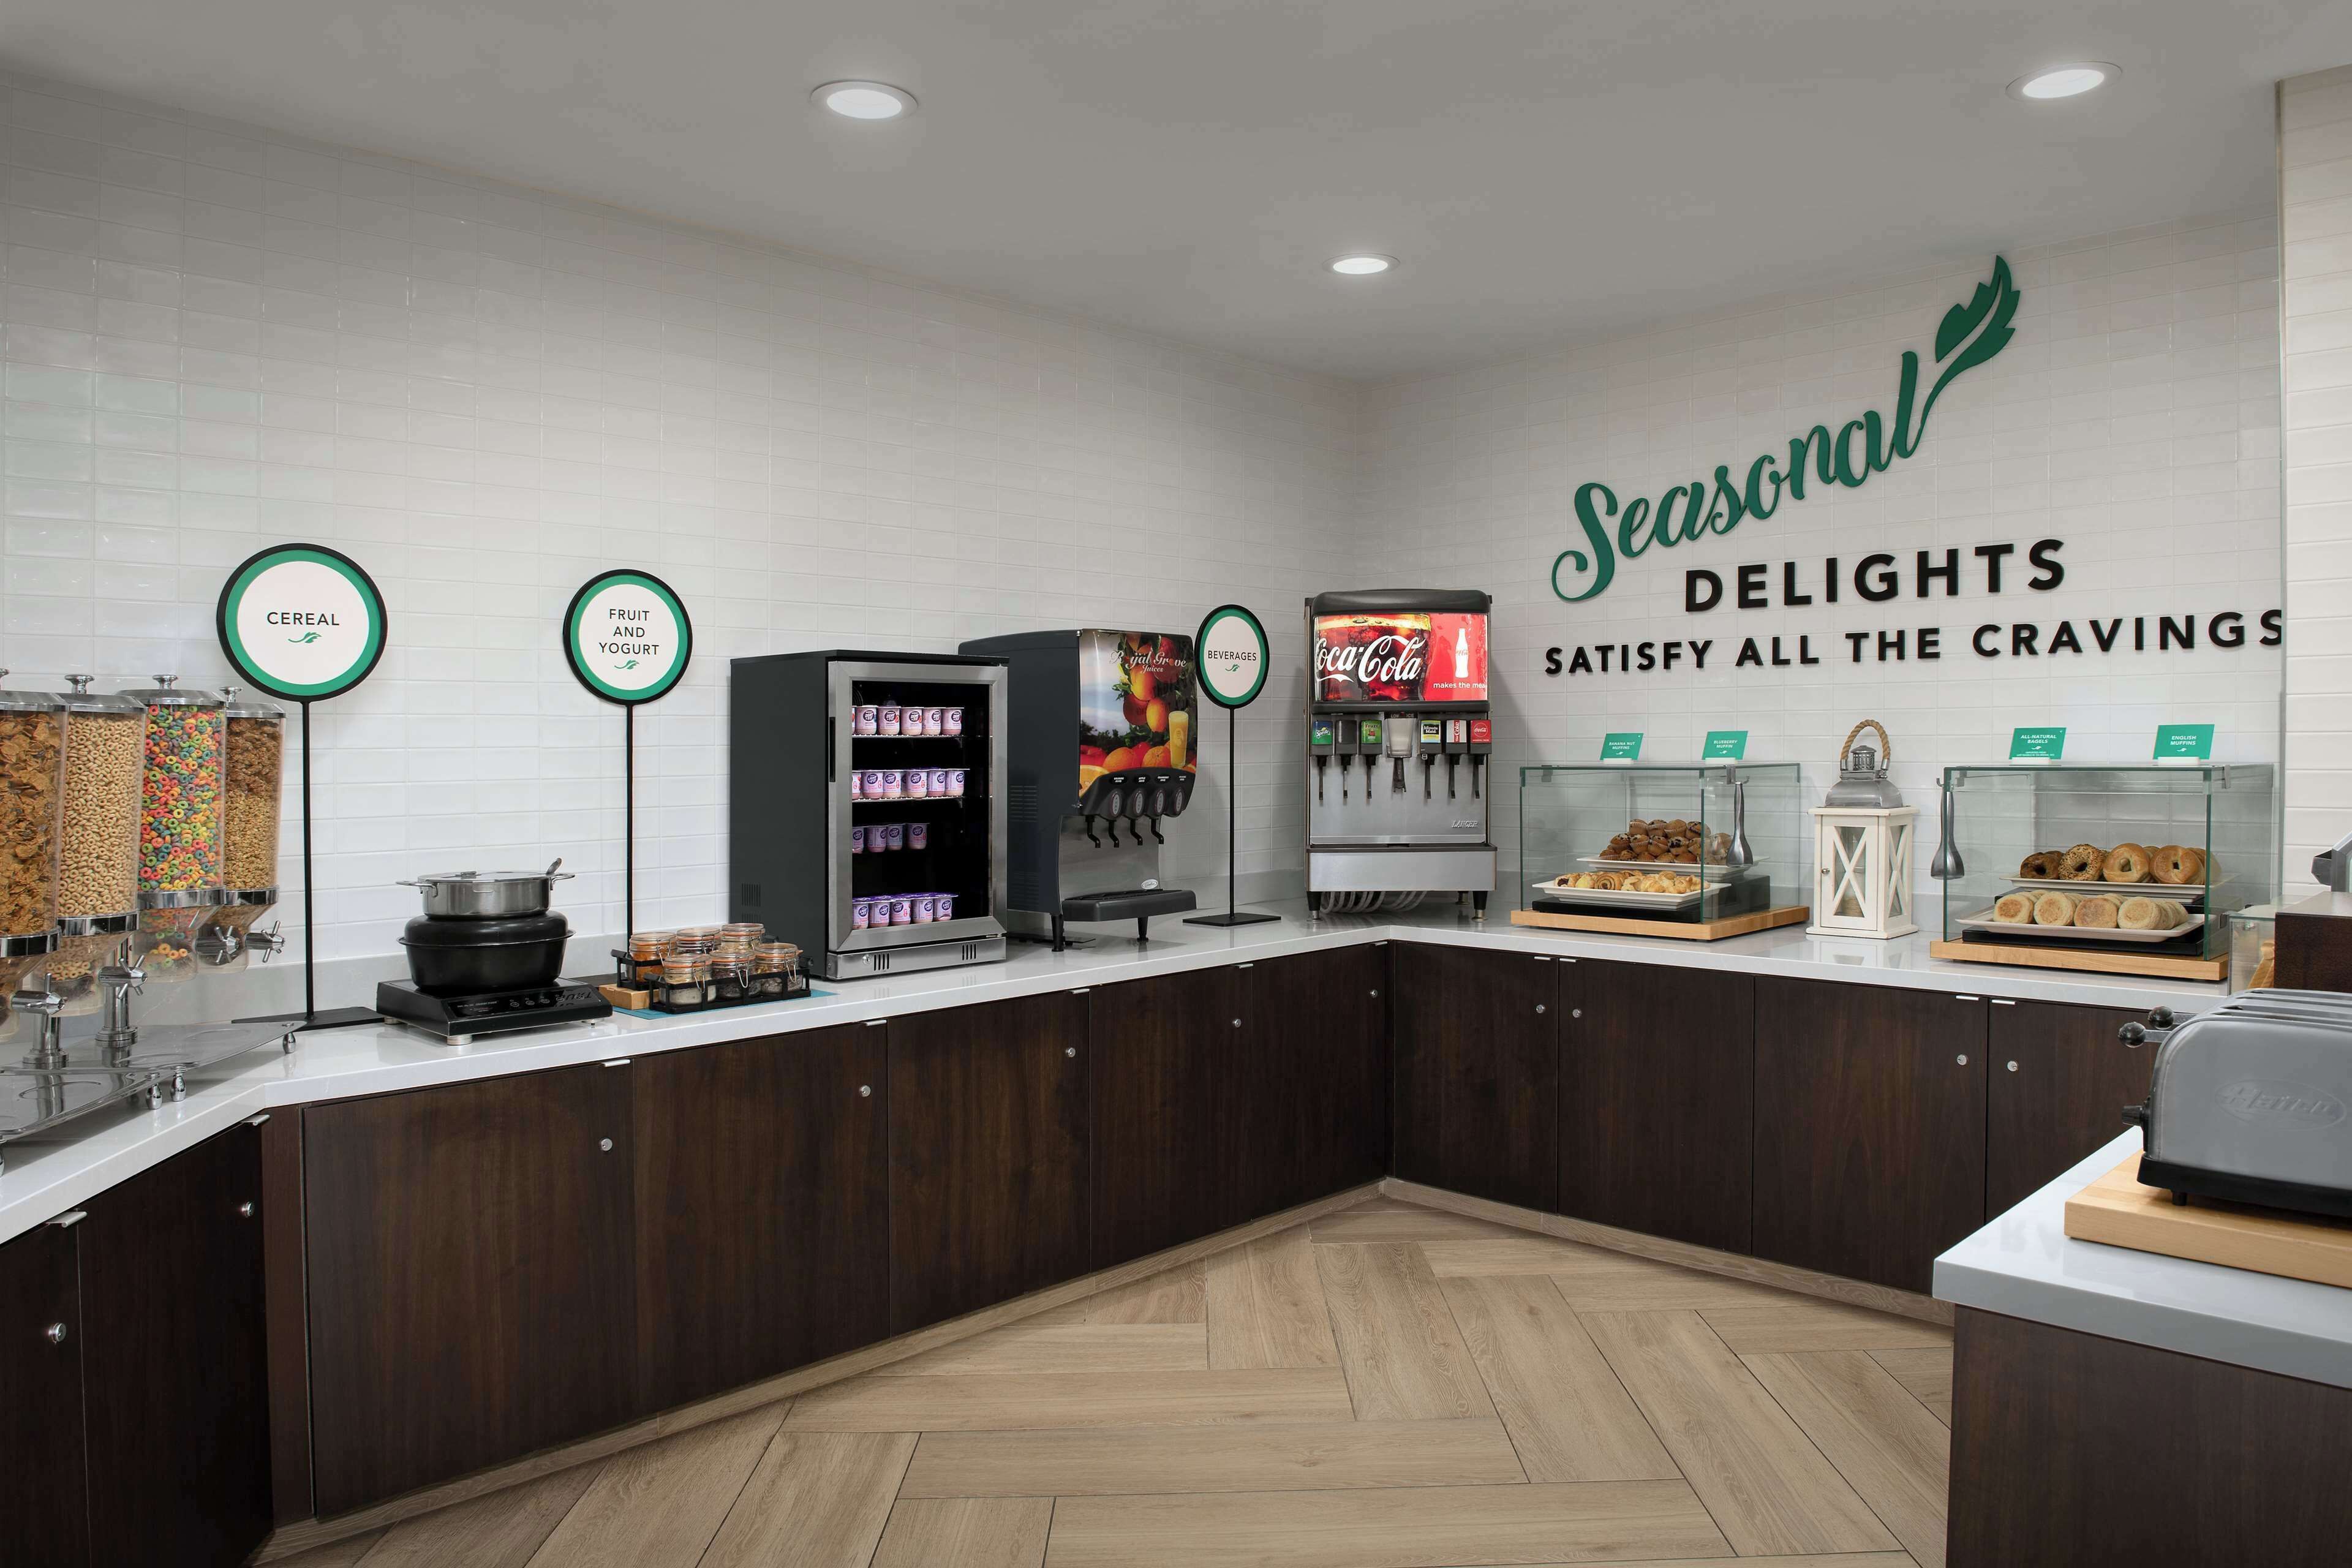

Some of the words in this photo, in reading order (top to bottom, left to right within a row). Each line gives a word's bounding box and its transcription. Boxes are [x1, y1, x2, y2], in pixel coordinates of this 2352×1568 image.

[1551, 350, 1939, 603] Seasonal
[1686, 539, 2064, 612] DELIGHTS
[267, 611, 340, 626] CEREAL
[609, 609, 650, 621] FRUIT
[613, 626, 645, 638] AND
[1545, 641, 1713, 674] SATISFY
[1736, 636, 1819, 666] ALL
[1845, 628, 1940, 662] THE
[1973, 609, 2282, 657] CRAVINGS
[599, 642, 660, 655] YOGURT
[1208, 650, 1257, 661] BEVERAGES
[1316, 729, 1330, 739] Sprite
